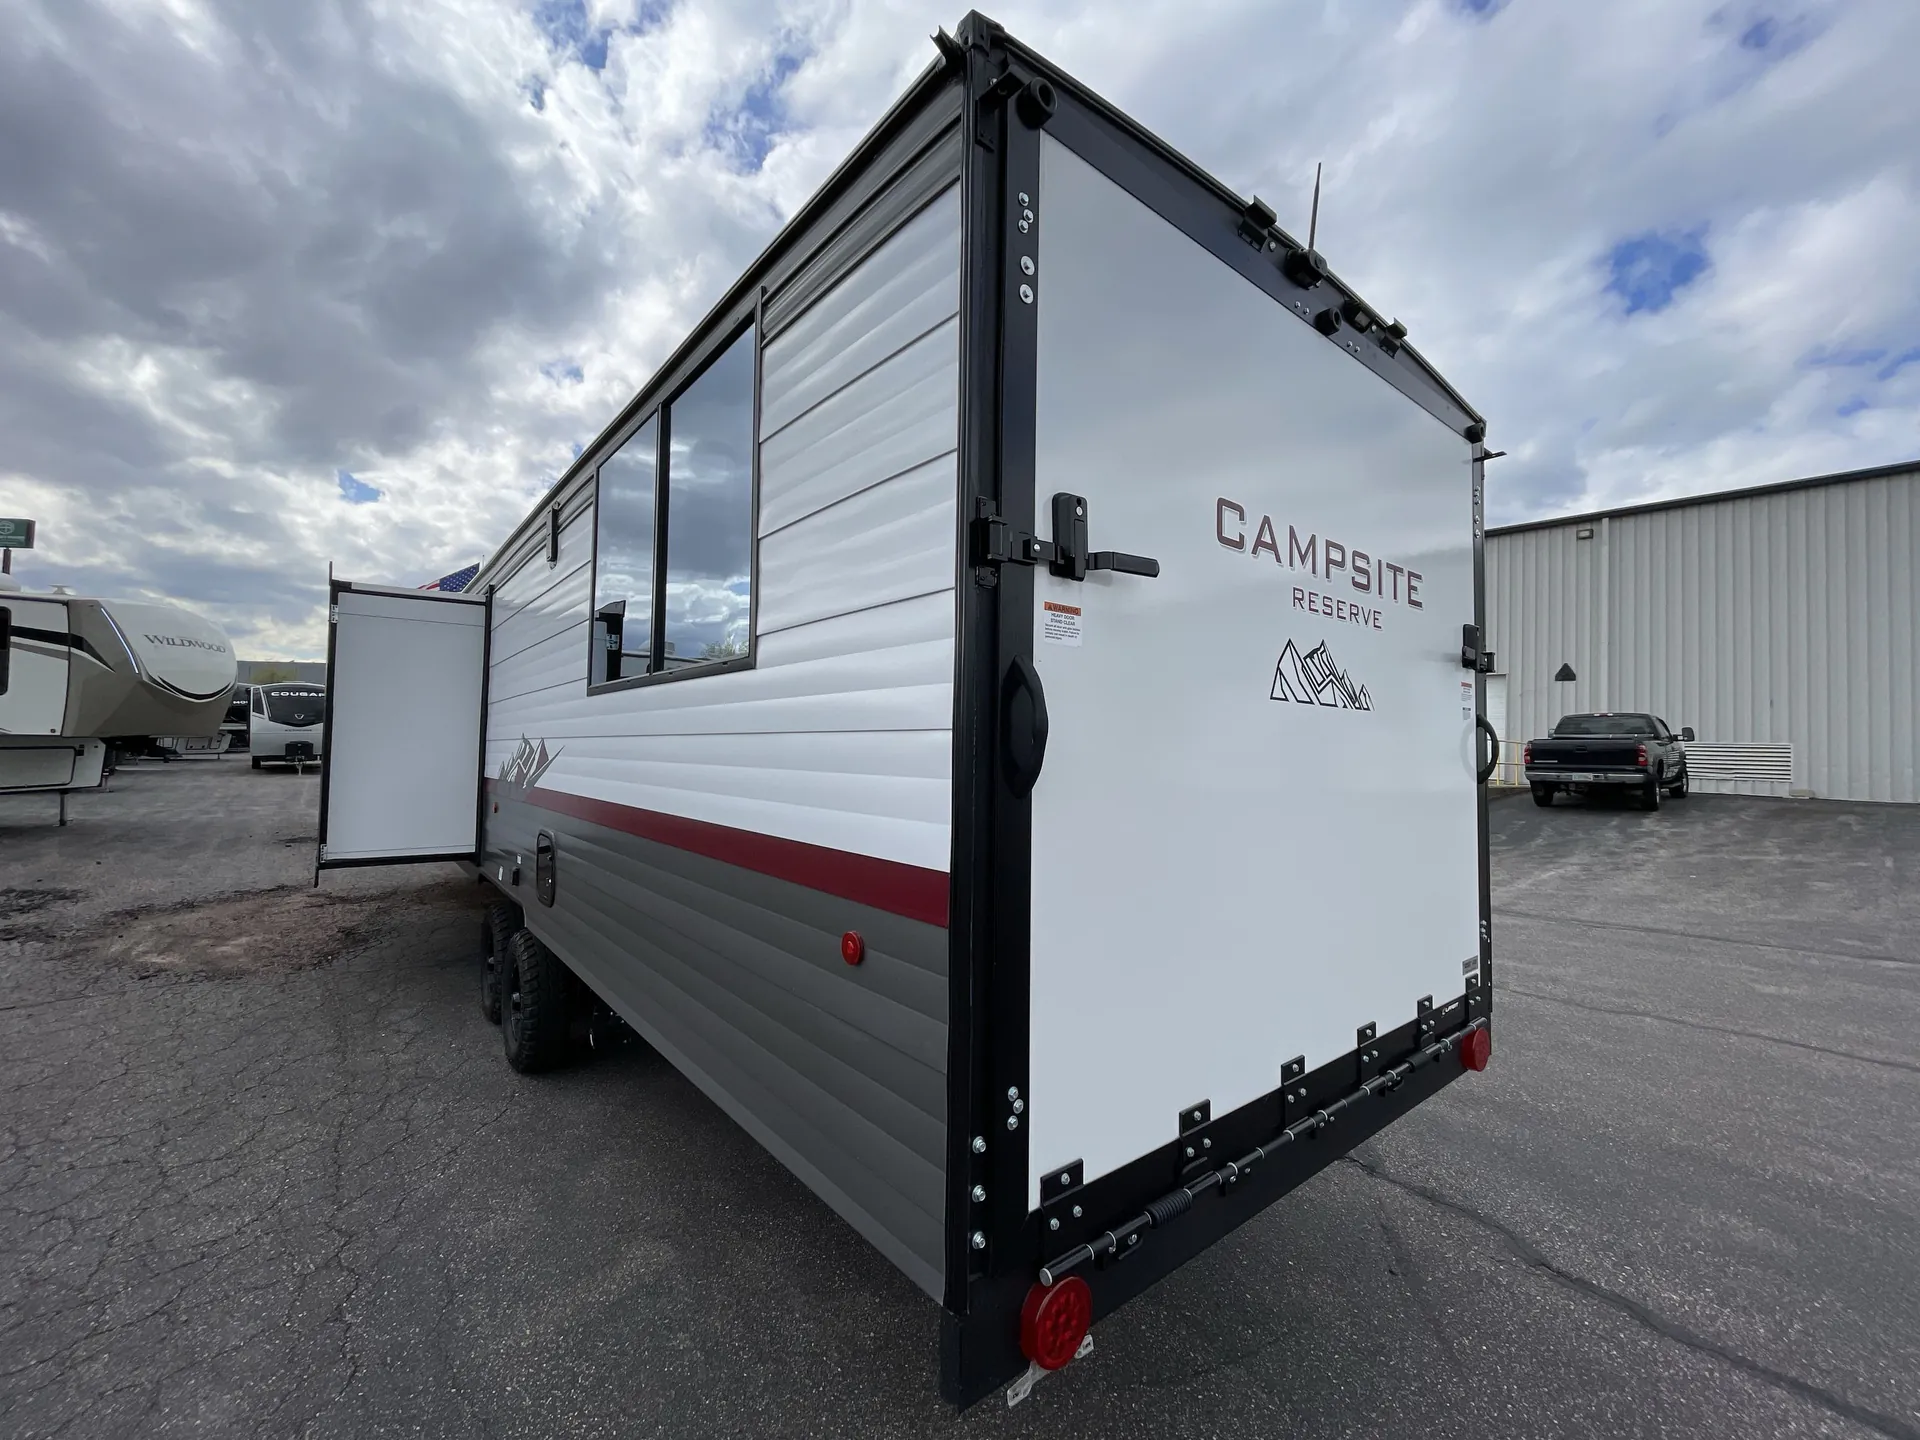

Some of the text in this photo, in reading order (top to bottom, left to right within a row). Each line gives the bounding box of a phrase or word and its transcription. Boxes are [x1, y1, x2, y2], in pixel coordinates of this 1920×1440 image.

[1216, 496, 1424, 609] CAMPSITE
[1292, 586, 1383, 629] RESERVE
[144, 634, 226, 653] WILDWOOD
